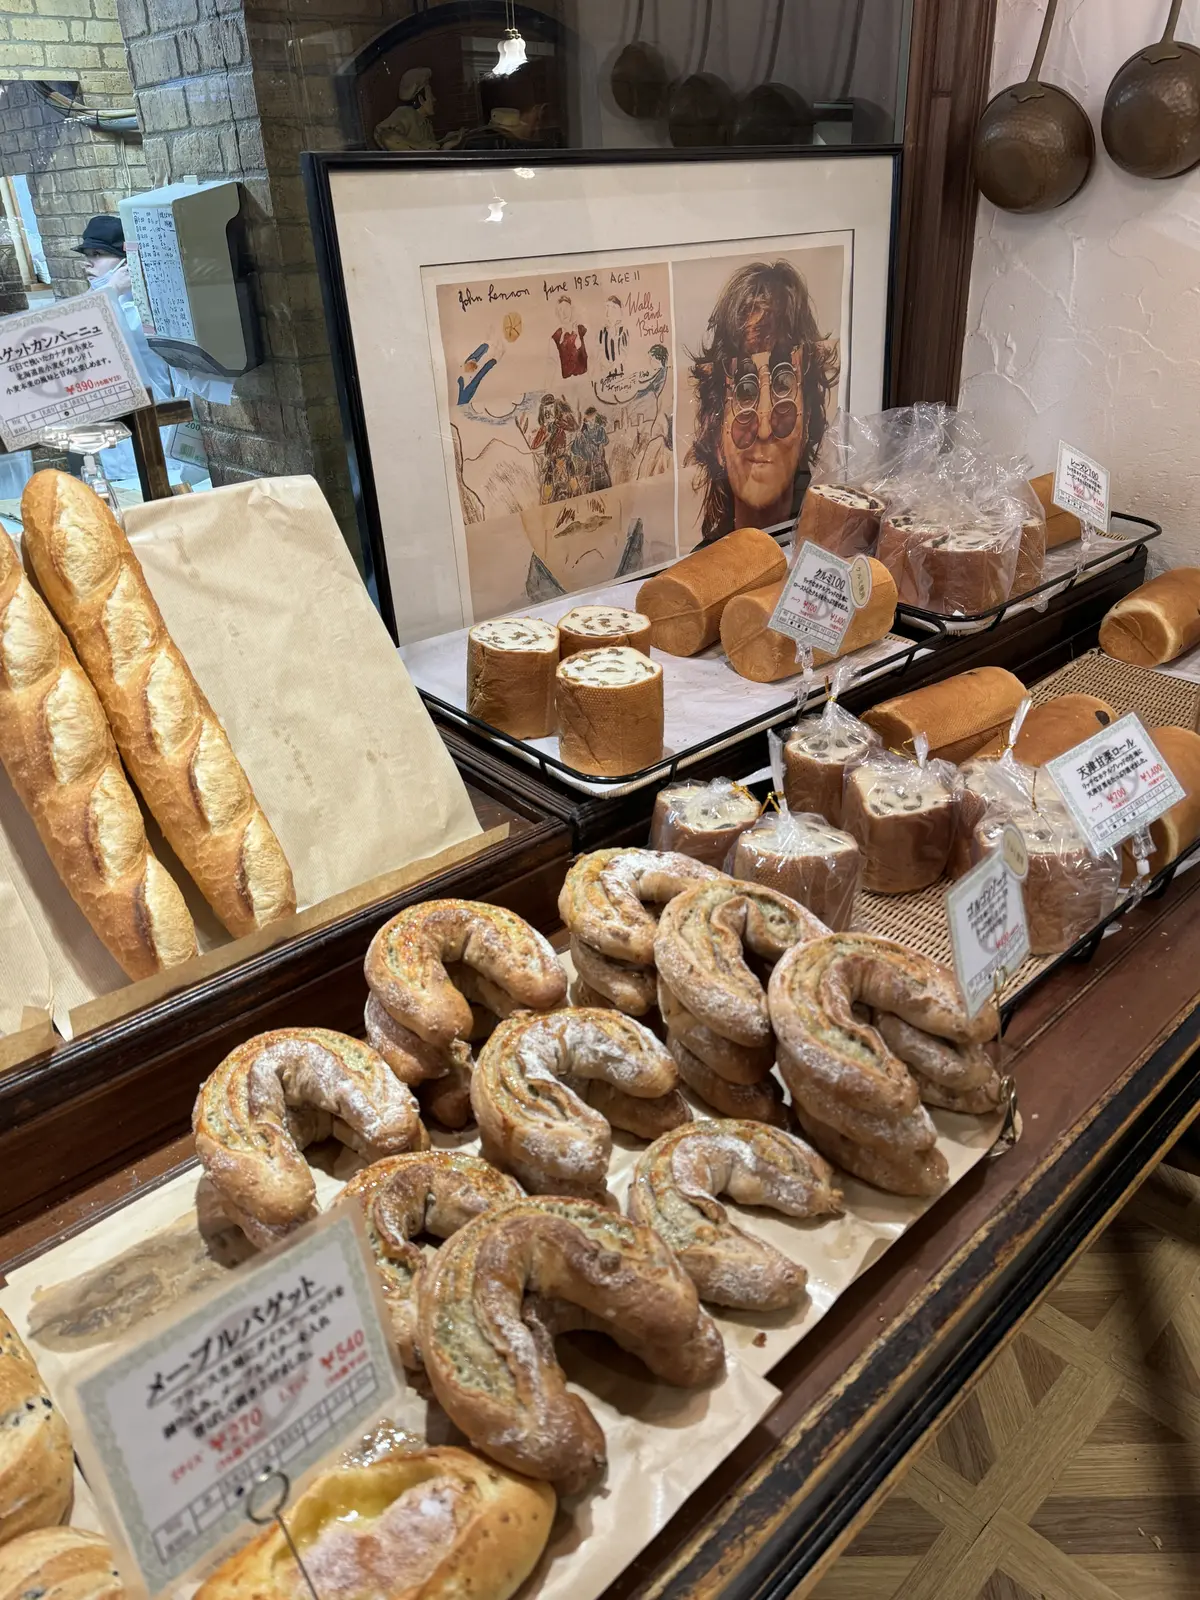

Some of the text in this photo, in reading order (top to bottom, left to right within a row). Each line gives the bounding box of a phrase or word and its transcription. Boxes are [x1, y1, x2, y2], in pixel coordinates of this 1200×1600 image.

[458, 287, 482, 312] John
[487, 284, 531, 302] Lennon
[573, 274, 600, 290] 1952
[610, 271, 631, 285] AGE
[625, 291, 654, 317] Walls
[643, 301, 663, 320] and
[636, 320, 670, 343] Bridges
[813, 568, 845, 590] クルミ100
[1076, 739, 1133, 778] 天津甘栗ロール
[1105, 787, 1126, 803] ¥700
[1139, 763, 1162, 781] ¥1,400
[149, 1277, 313, 1394] メープルバゲット
[208, 1407, 263, 1451] ¥270
[320, 1330, 363, 1369] ¥540
